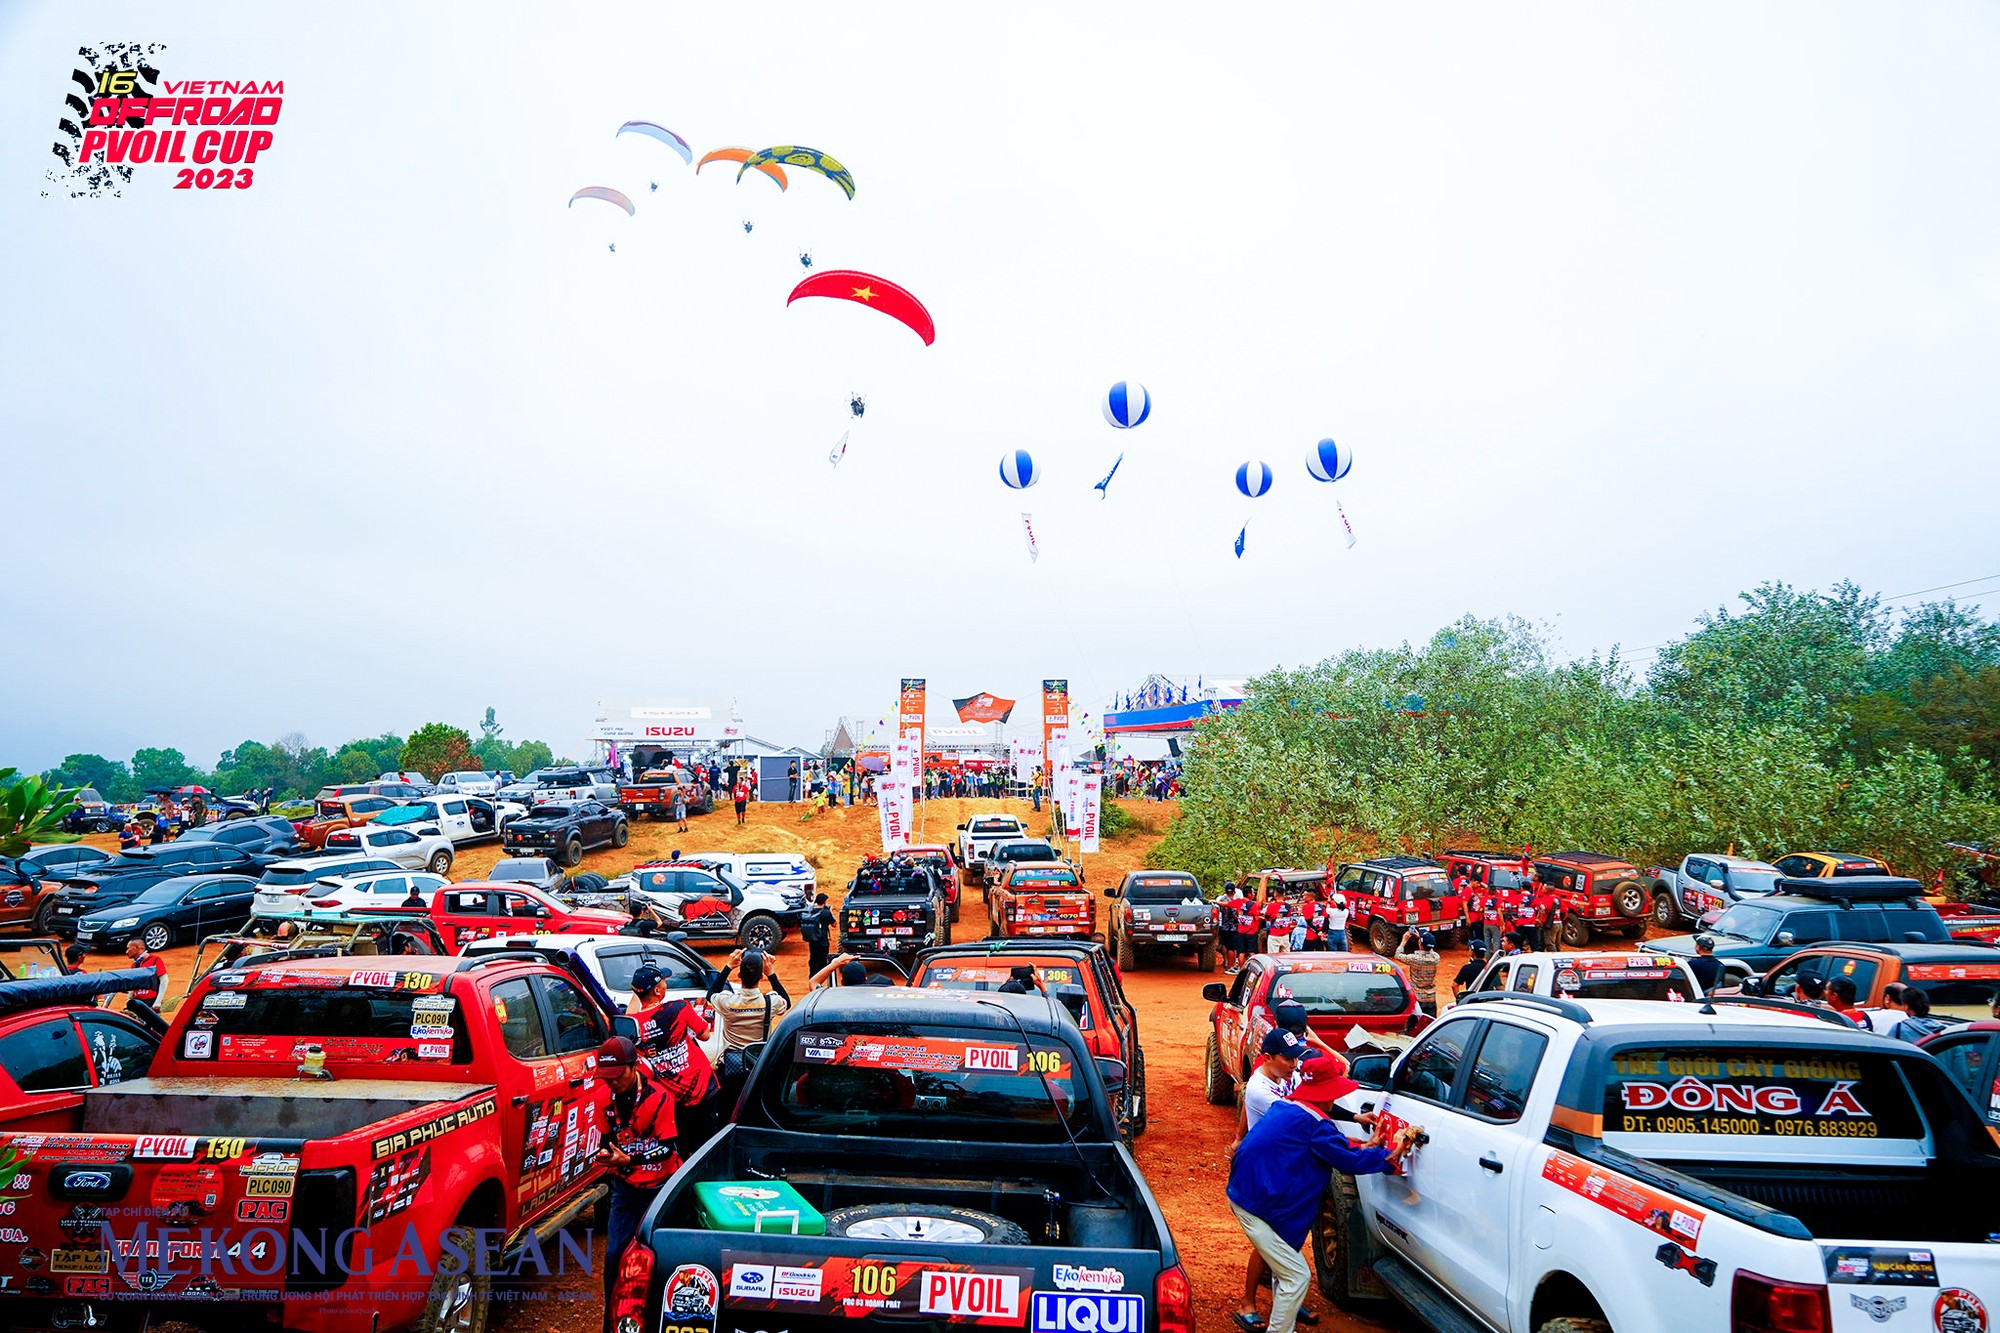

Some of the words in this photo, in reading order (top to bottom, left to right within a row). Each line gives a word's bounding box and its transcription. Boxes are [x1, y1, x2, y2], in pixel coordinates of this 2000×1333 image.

[645, 726, 695, 737] ISUZU
[888, 811, 902, 841] PVOIL
[1084, 812, 1097, 841] PVOIL
[1375, 963, 1391, 973] 210
[1655, 957, 1672, 967] 109
[352, 971, 392, 987] PVOIL
[403, 972, 432, 990] 130
[1047, 970, 1068, 981] 306
[643, 1019, 657, 1031] 130
[670, 1052, 689, 1068] CUP
[969, 1049, 1014, 1069] PVOIL
[1026, 1051, 1061, 1074] 106
[1621, 1075, 1802, 1116] ĐÔNG
[1815, 1080, 1872, 1117] Á
[375, 1134, 406, 1159] GIA
[410, 1116, 455, 1147] PHÚC
[456, 1099, 496, 1128] AUTO
[1623, 1115, 1652, 1132] ĐT:
[1656, 1116, 1760, 1135] 0905.145000
[1775, 1119, 1878, 1138] 0976.883929
[138, 1136, 190, 1158] PVOIL
[206, 1137, 247, 1159] 130
[73, 1175, 101, 1188] Ford
[240, 1202, 286, 1219] PAC
[831, 1212, 848, 1224] STT
[850, 1208, 869, 1217] PRO
[950, 1209, 999, 1228] COOPER
[781, 1270, 817, 1280] BFGoodrich
[851, 1264, 898, 1296] 106
[1055, 1266, 1123, 1286] Ekokemika
[69, 1279, 107, 1294] PAC
[735, 1285, 767, 1293] SUBARU
[778, 1287, 816, 1298] ISUZU
[928, 1275, 1010, 1315] PVOIL
[885, 1298, 902, 1309] PHÁT
[1038, 1296, 1138, 1333] LIQUI
